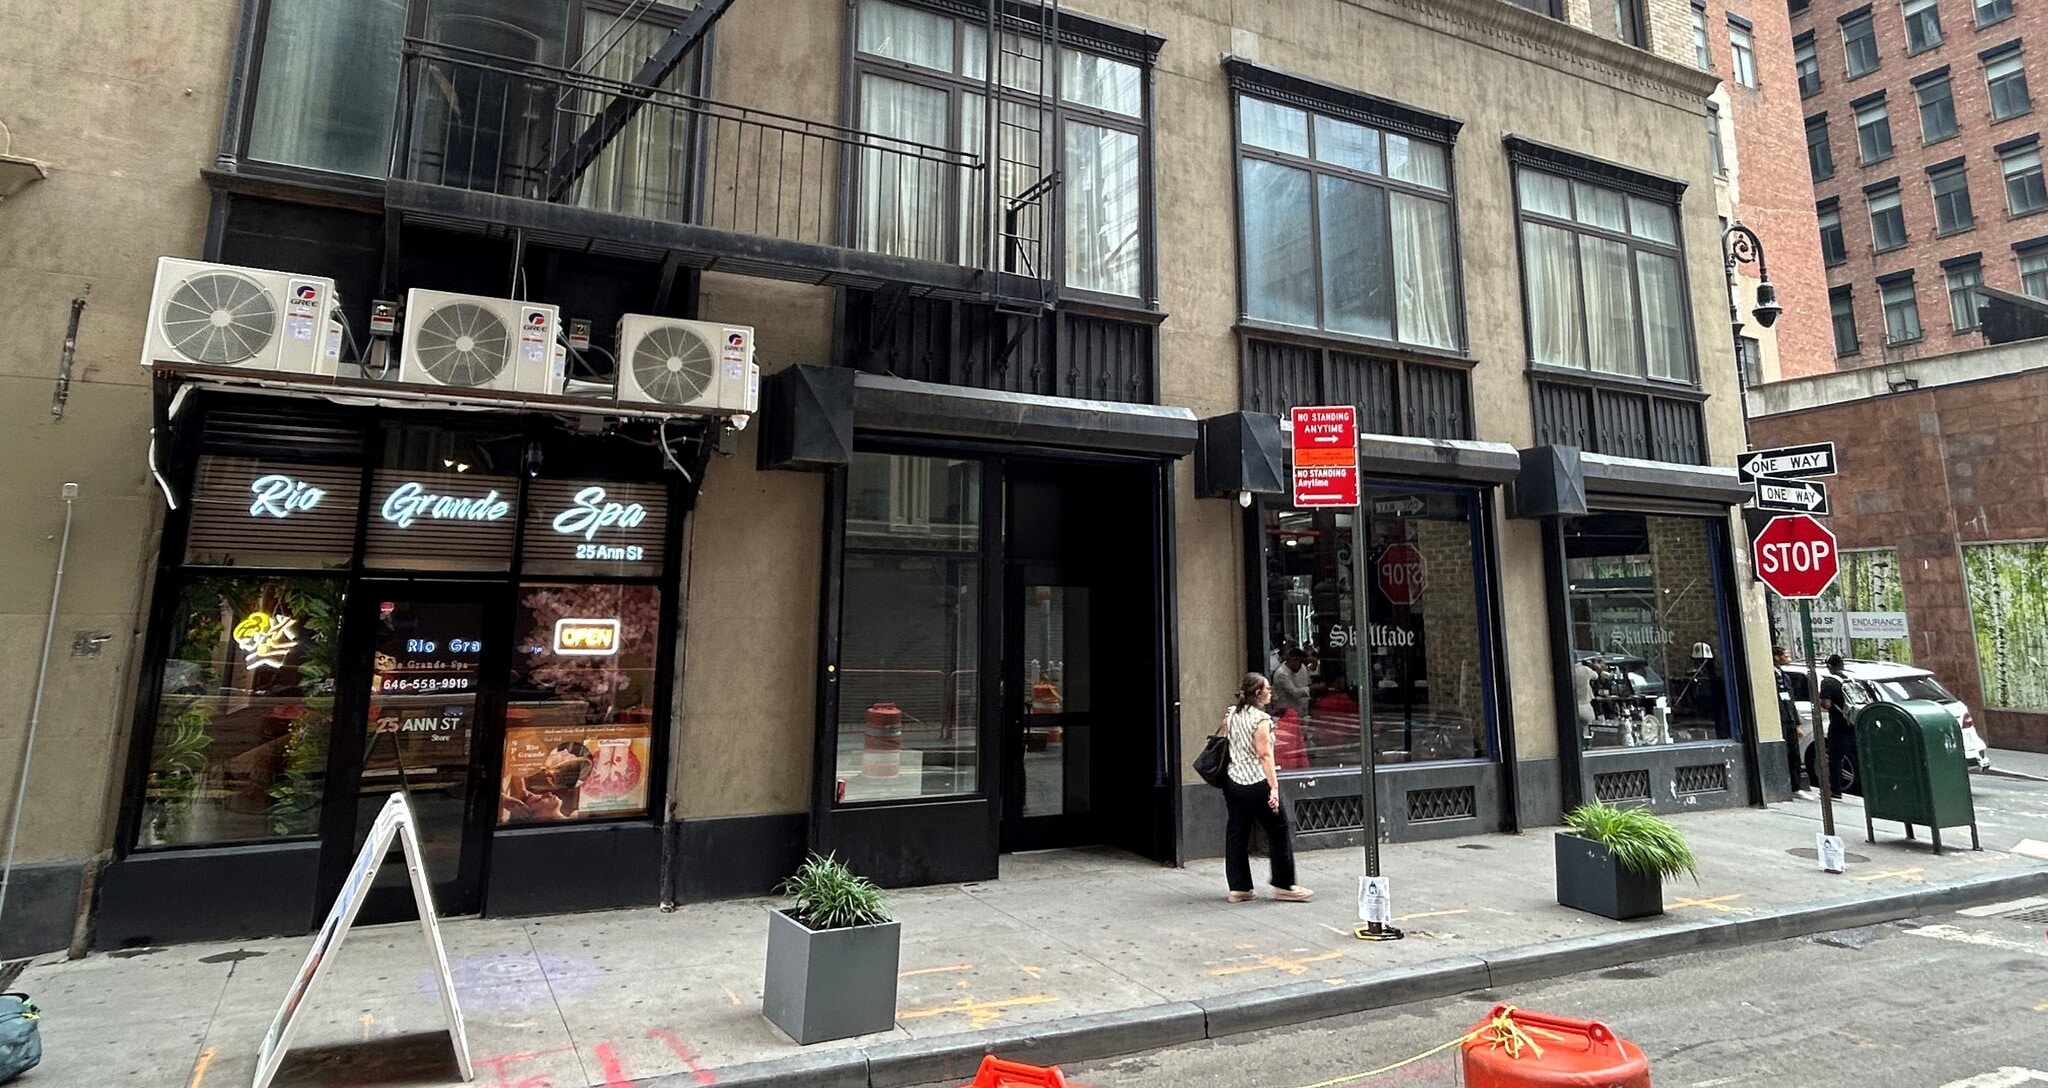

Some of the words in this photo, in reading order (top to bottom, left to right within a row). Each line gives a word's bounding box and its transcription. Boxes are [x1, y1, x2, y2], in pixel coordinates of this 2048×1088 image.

[1297, 413, 1308, 421] NO
[1311, 412, 1349, 421] STANDING
[1304, 424, 1344, 433] ANYTIME
[1751, 459, 1778, 473] ONE
[1790, 454, 1820, 469] WAY
[1297, 469, 1308, 477] NO
[1310, 469, 1347, 477] STANDING
[1298, 479, 1329, 488] Anytime
[1766, 487, 1787, 501] ONE
[1795, 491, 1816, 503] WAY
[249, 474, 327, 518] Rio
[381, 481, 510, 529] Grande
[552, 486, 647, 541] Spa
[575, 544, 596, 559] 25
[596, 545, 624, 560] Ann
[625, 545, 644, 560] St
[1762, 540, 1830, 573] STOP
[1852, 618, 1904, 626] ENDURANCE
[561, 627, 613, 647] OPEN
[1329, 624, 1415, 647] Skllfade
[1611, 626, 1674, 644] Skullfade
[407, 639, 436, 653] Rio
[448, 638, 481, 653] Gra
[407, 660, 445, 669] Grande
[451, 660, 468, 671] Spa
[383, 678, 469, 690] 646-558-9919
[376, 717, 399, 733] 25
[402, 717, 437, 732] ANN
[440, 717, 460, 730] ST
[431, 733, 450, 742] Store
[525, 743, 540, 751] Rio
[517, 751, 546, 759] Grande
